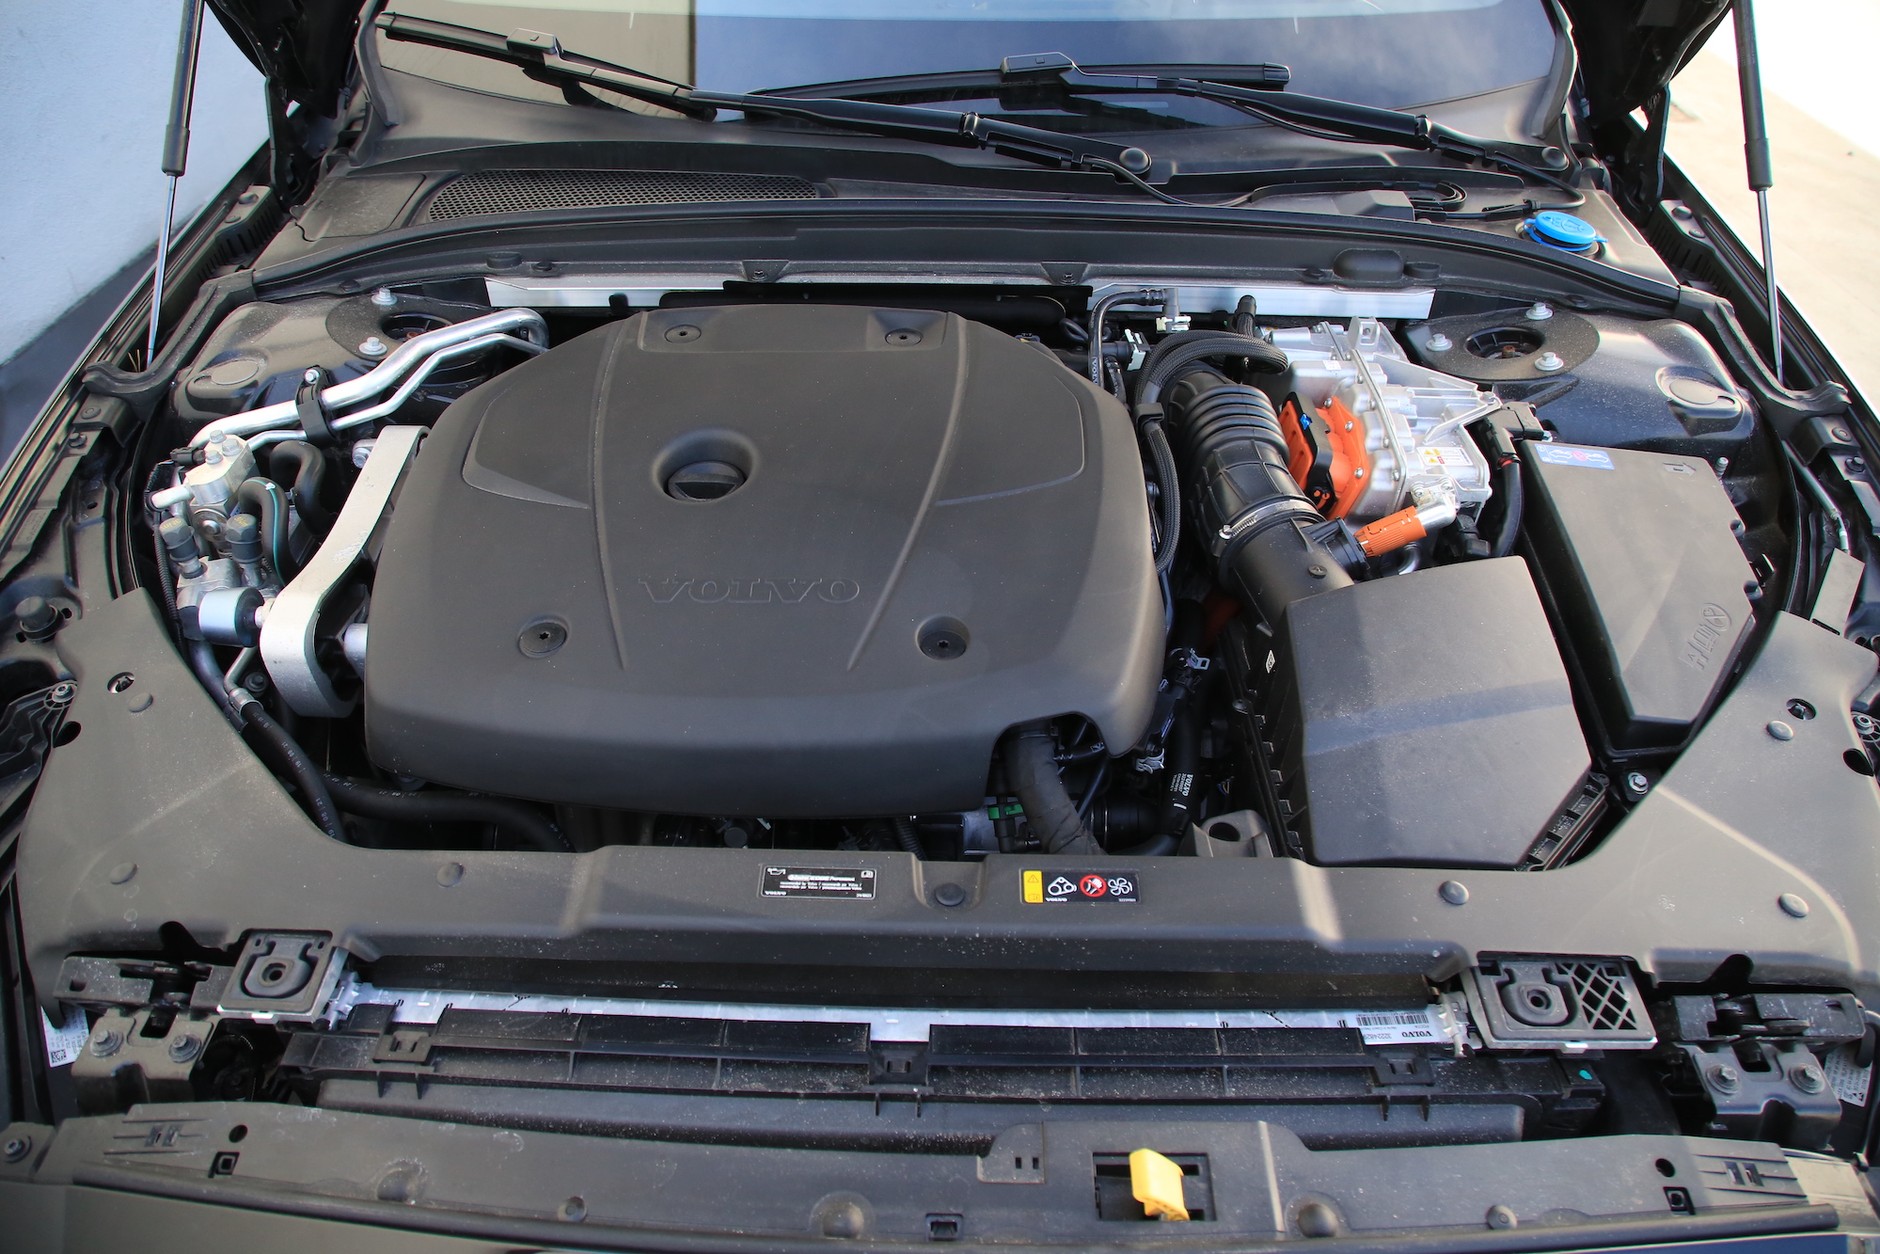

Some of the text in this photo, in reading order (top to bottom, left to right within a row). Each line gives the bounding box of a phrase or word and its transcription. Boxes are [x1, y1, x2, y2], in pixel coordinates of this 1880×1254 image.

[638, 578, 860, 603] VOLVO
[1182, 773, 1194, 797] VOLVO
[1401, 1030, 1432, 1038] VOLVO
